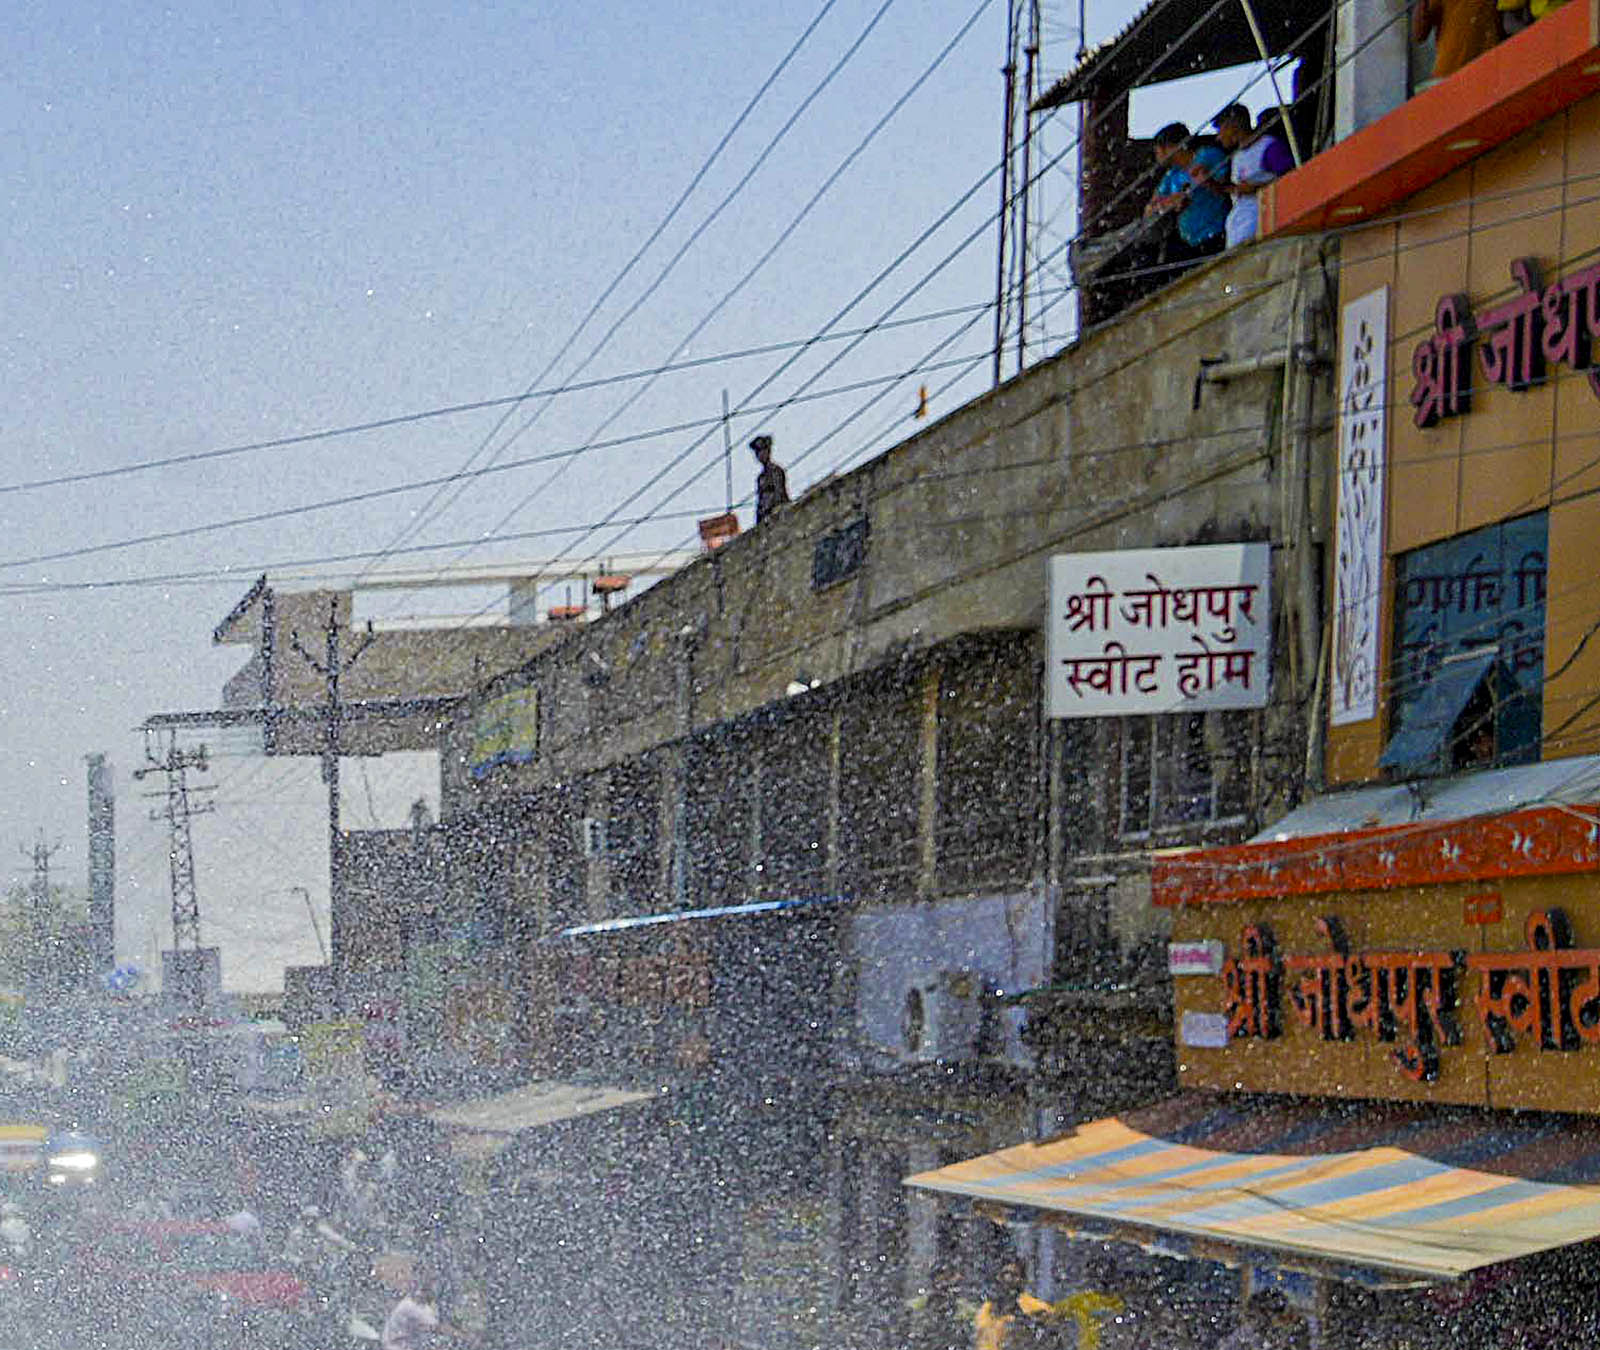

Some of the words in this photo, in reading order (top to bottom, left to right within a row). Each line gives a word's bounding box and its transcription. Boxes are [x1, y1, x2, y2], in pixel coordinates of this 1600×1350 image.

[1411, 292, 1472, 427] श्री
[1064, 576, 1115, 632] श्री
[1119, 572, 1258, 643] जोधपुर
[1062, 641, 1162, 698] स्वीट
[1174, 635, 1256, 698] होम
[1222, 922, 1276, 1039] श्री
[1285, 915, 1462, 1083] जोधपुर
